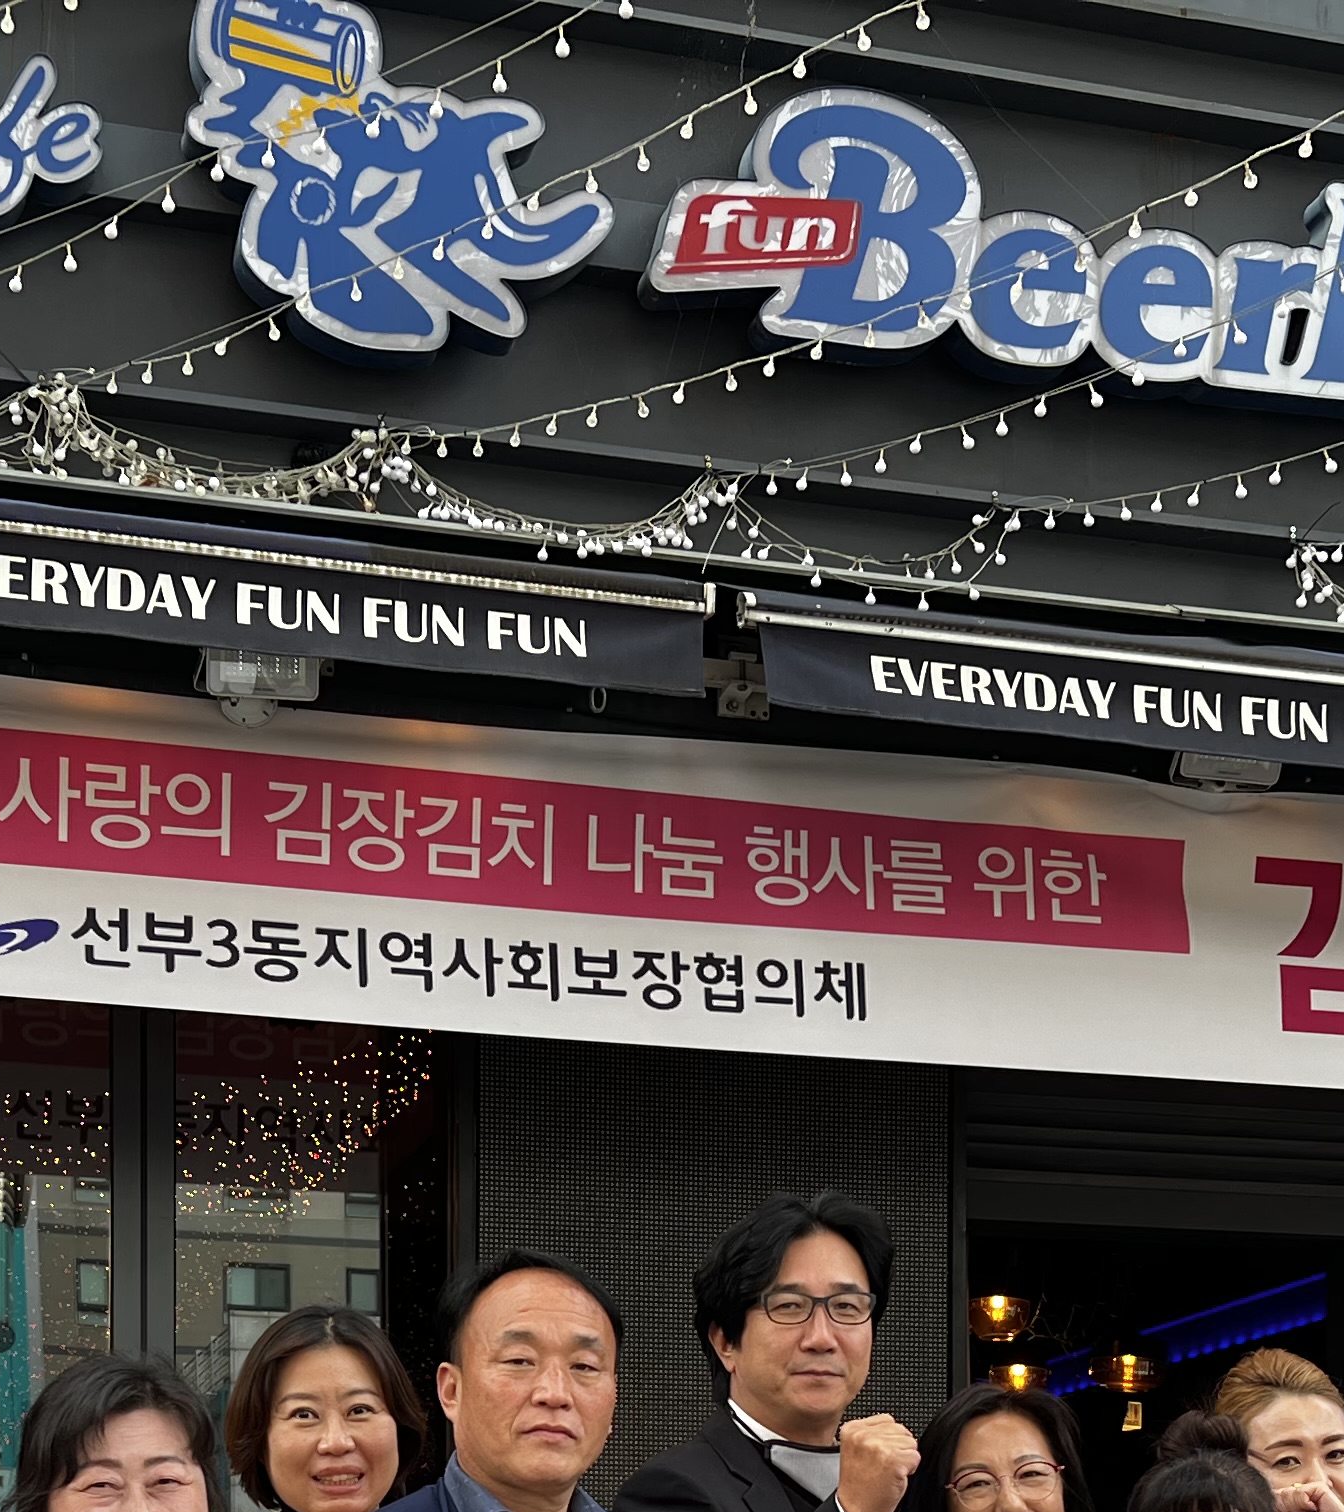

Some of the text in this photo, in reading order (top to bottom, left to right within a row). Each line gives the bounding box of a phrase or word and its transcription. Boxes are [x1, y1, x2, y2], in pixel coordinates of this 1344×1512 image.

[698, 200, 837, 257] fun
[235, 582, 342, 634] FUN
[362, 598, 465, 648] FUN
[487, 612, 588, 658] FUN
[870, 655, 1118, 720] EVERYDAY
[1133, 684, 1223, 733] FUN
[1240, 698, 1329, 743] FUN
[265, 777, 555, 886] 김장김치
[587, 812, 724, 901] 나눔
[745, 824, 954, 916] 행사를
[973, 845, 1108, 926] 위한
[69, 905, 870, 1023] 선부3동지역사회보장협의체
